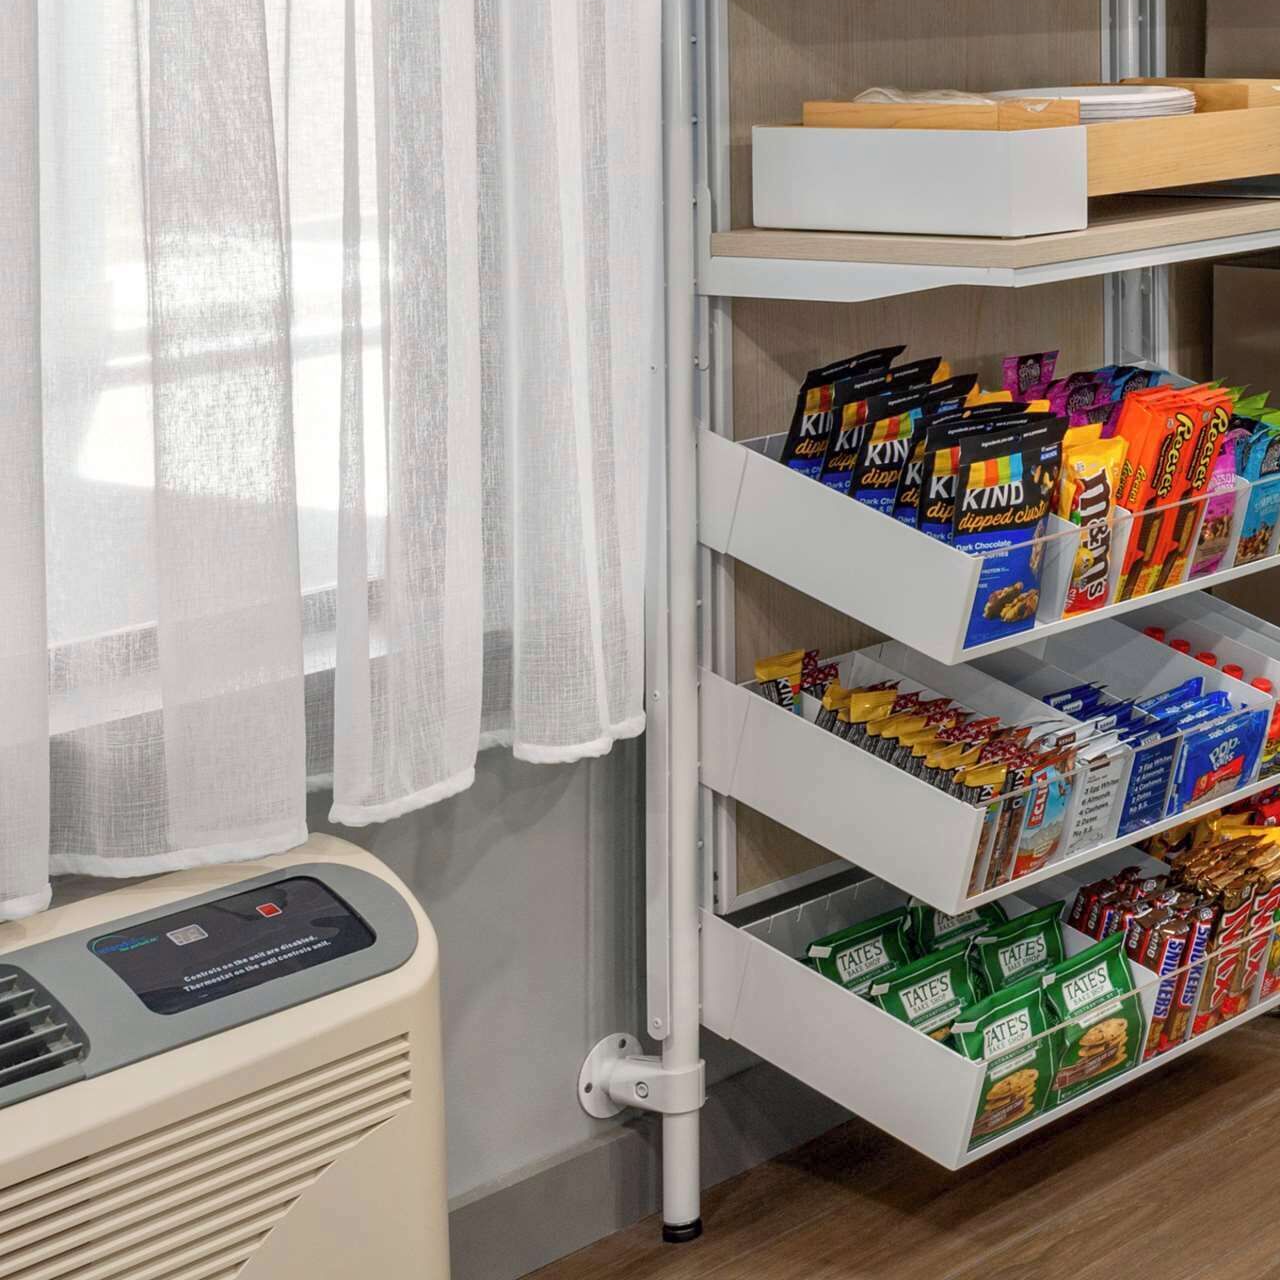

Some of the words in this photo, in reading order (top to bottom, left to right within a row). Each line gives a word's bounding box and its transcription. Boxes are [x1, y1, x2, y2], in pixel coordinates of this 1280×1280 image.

[962, 481, 1024, 512] KIND
[958, 508, 1015, 534] dipped
[838, 938, 883, 970] TATE'S
[1001, 938, 1045, 966] TATE'S
[183, 972, 234, 993] Thermostat
[184, 966, 222, 983] Controls
[234, 957, 249, 966] the
[1064, 967, 1107, 1000] TATE'S
[902, 973, 950, 1008] TATE'S
